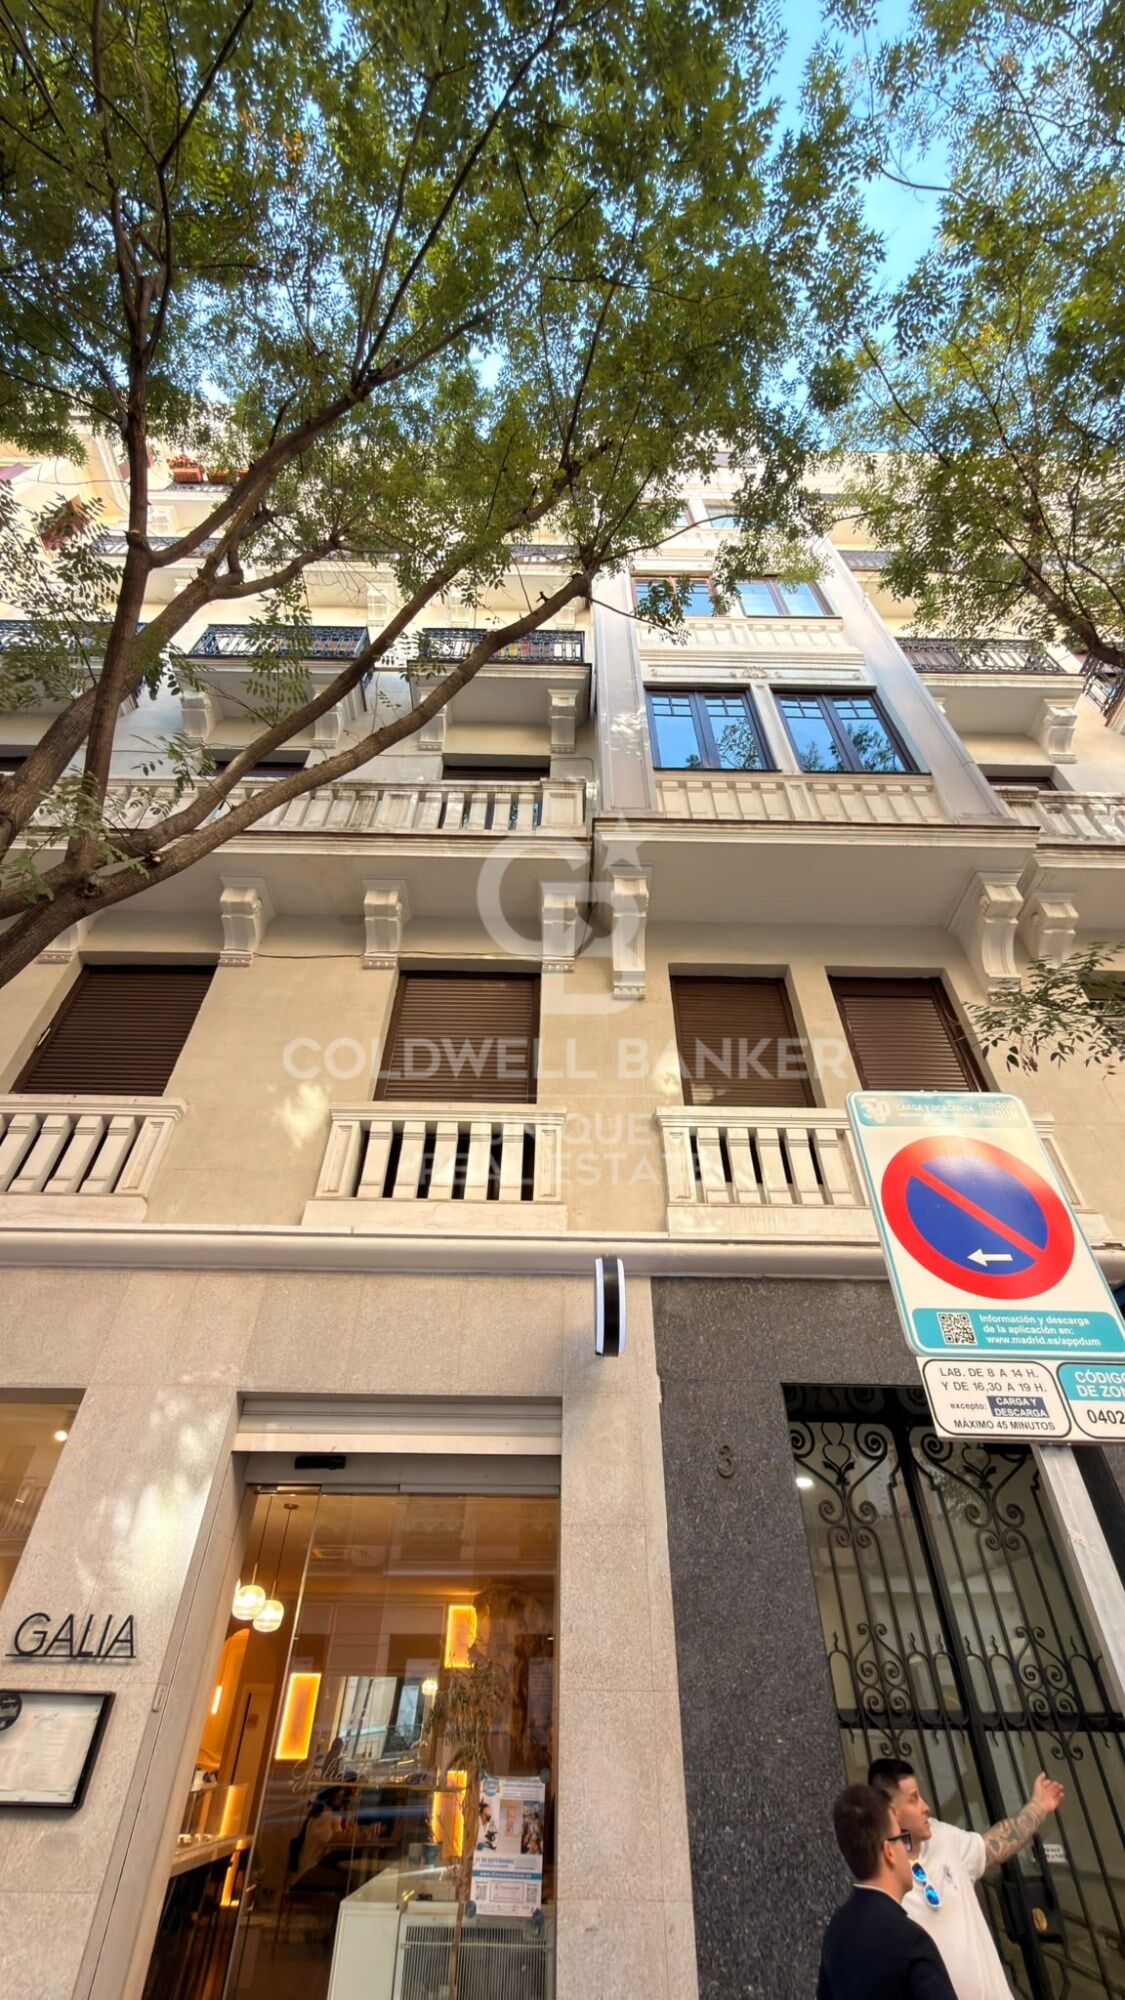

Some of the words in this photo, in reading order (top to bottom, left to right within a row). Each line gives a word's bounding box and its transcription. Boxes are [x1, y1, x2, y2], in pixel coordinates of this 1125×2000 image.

[979, 1314, 1036, 1323] Información
[1037, 1316, 1043, 1325] y
[1046, 1315, 1090, 1327] descarga
[983, 1325, 995, 1333] de
[997, 1325, 1006, 1333] la
[1008, 1325, 1057, 1335] aplicación
[1058, 1327, 1074, 1335] en:
[986, 1336, 1101, 1347] www.madrid.es/appdum
[940, 1367, 966, 1377] LAB.
[968, 1368, 984, 1378] DE
[987, 1368, 995, 1378] 8
[1000, 1368, 1008, 1378] A
[1011, 1368, 1023, 1378] 14
[1026, 1368, 1039, 1378] H.
[941, 1381, 948, 1391] Y
[953, 1381, 969, 1391] DE
[1007, 1382, 1015, 1392] A
[1020, 1382, 1031, 1392] 19
[1034, 1383, 1047, 1392] H.
[1076, 1384, 1099, 1397] DE
[950, 1402, 988, 1411] excepto:
[996, 1397, 1029, 1406] CARGA
[1029, 1397, 1036, 1406] Y
[994, 1408, 1047, 1417] DESCARGA
[1087, 1409, 1125, 1424] 0402
[954, 1418, 994, 1429] MÁXIMO
[997, 1420, 1008, 1430] 45
[1010, 1421, 1056, 1431] MINUTOS
[14, 1612, 135, 1658] GALIA
